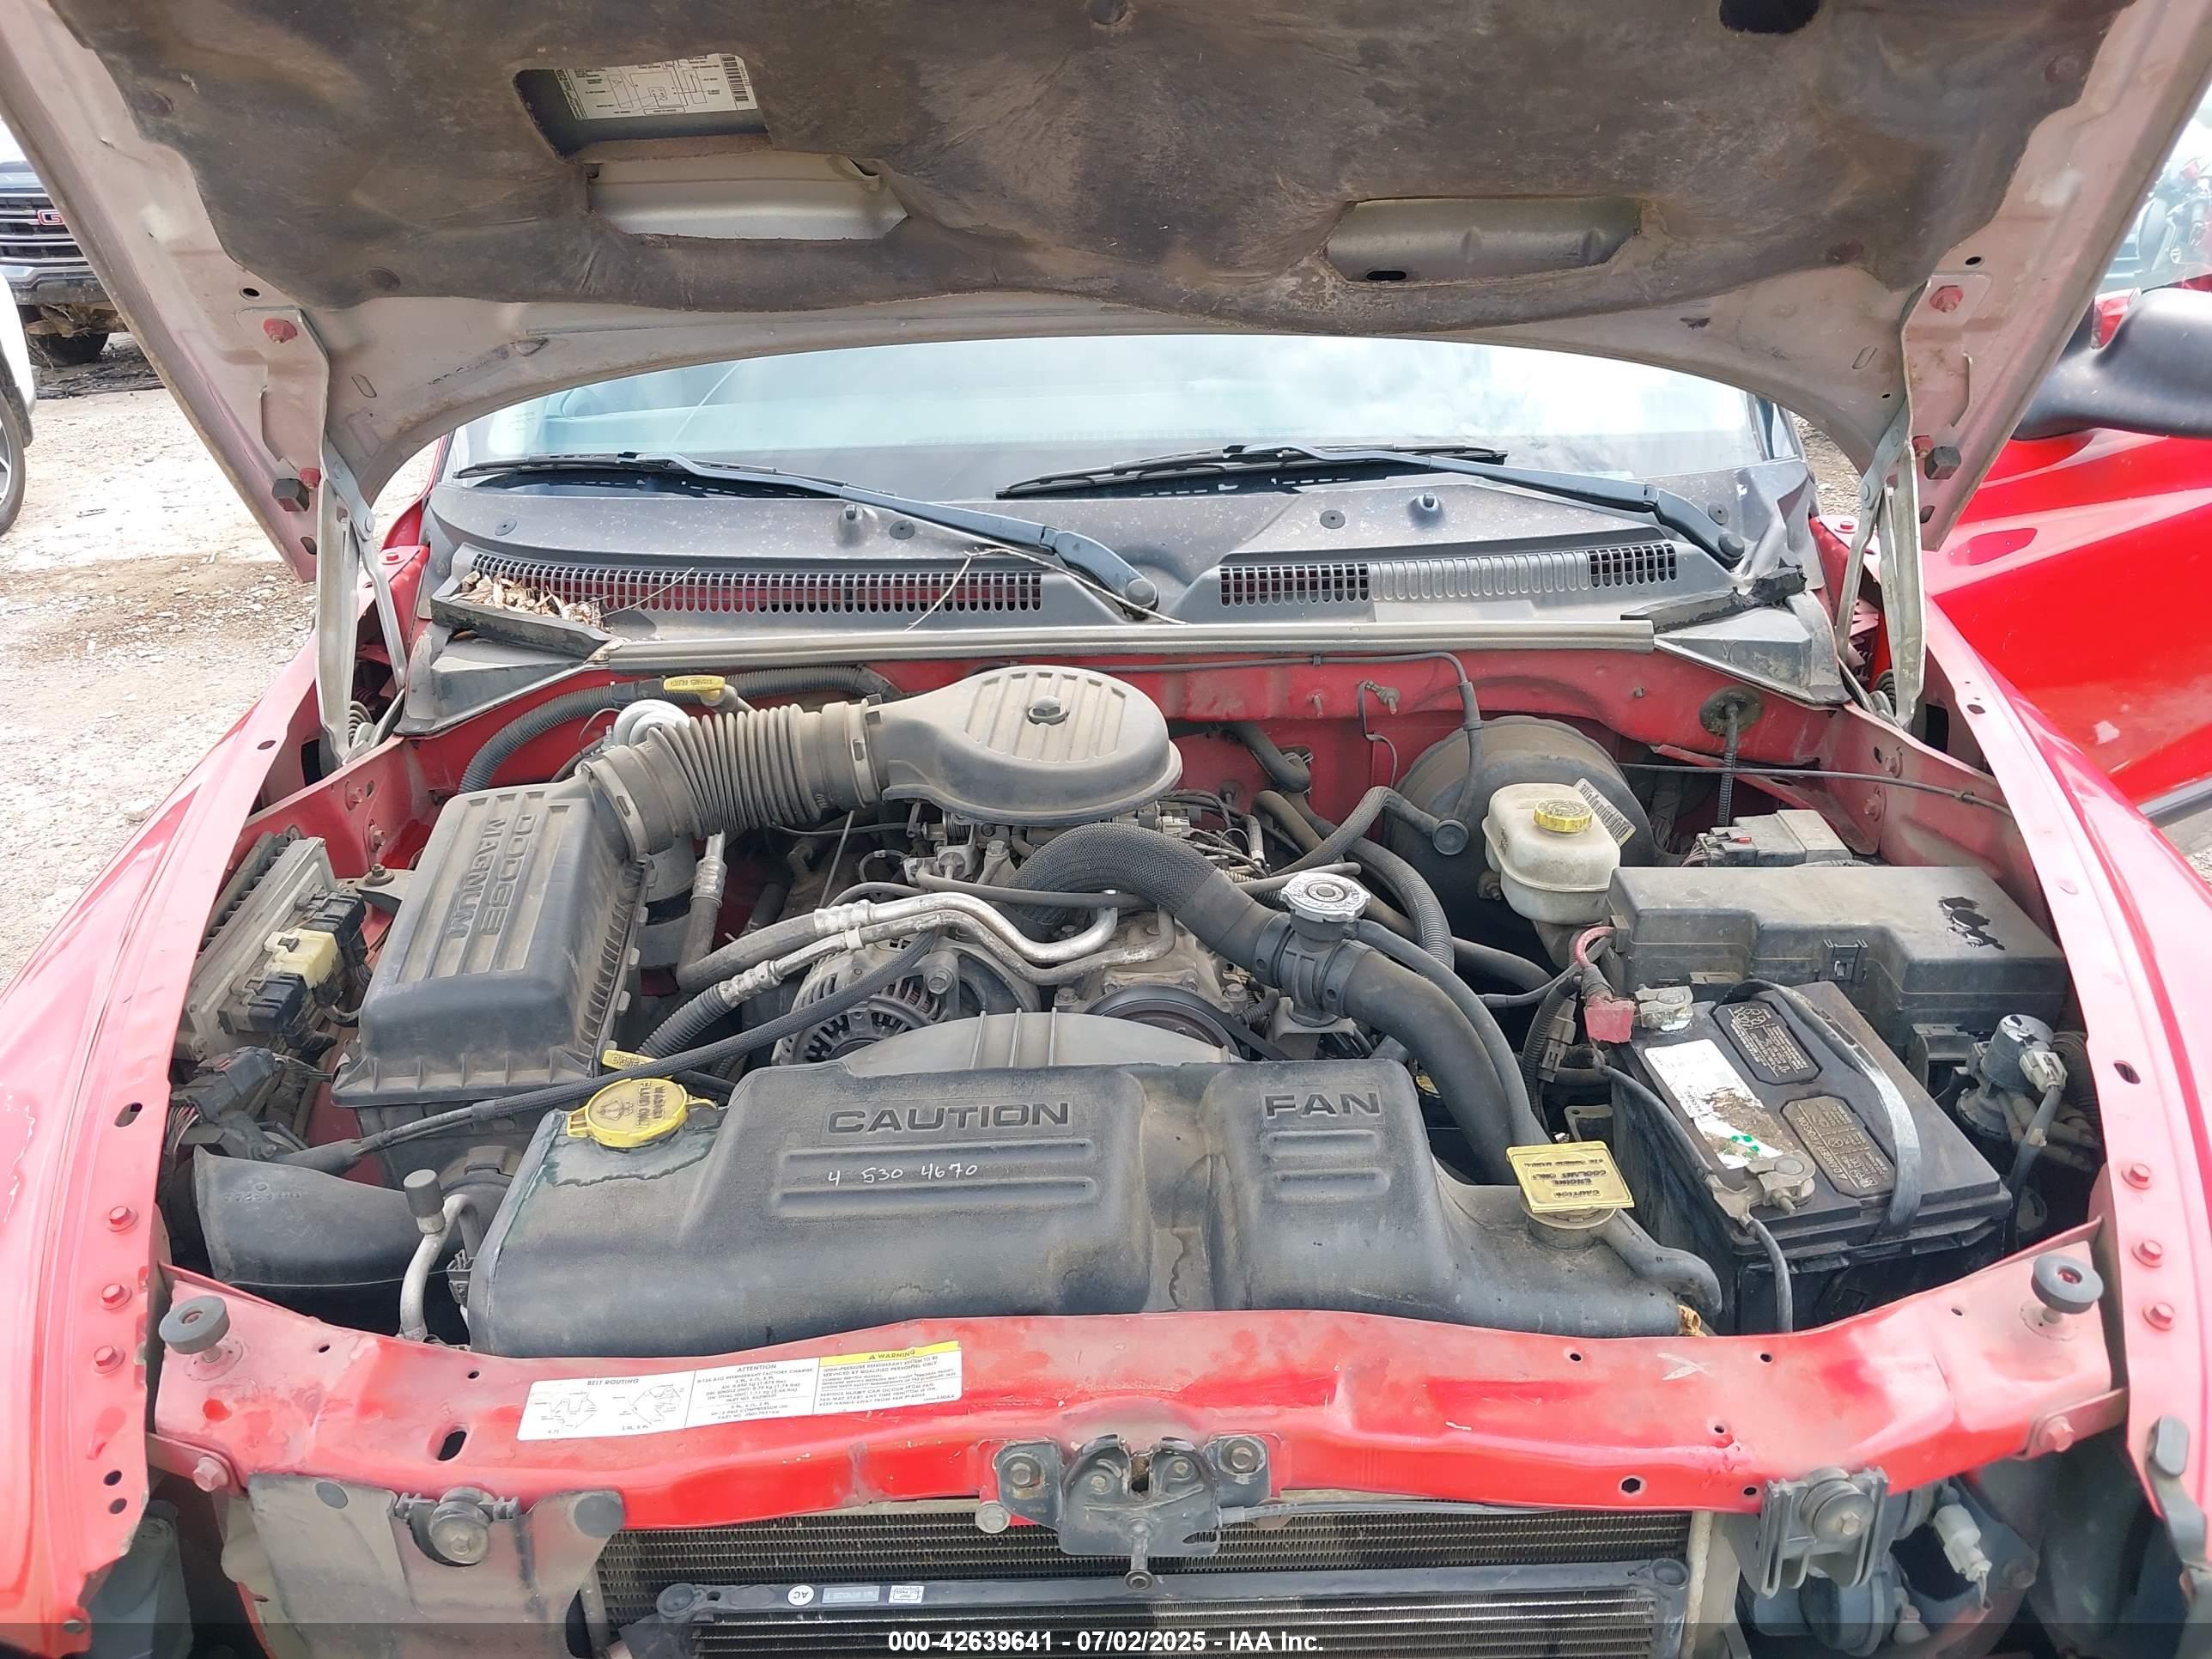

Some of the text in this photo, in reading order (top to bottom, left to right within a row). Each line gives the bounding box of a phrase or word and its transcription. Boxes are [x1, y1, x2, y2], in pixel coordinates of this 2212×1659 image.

[447, 817, 507, 939] MAGNUM
[481, 813, 533, 935] DODGE
[612, 1054, 639, 1067] ENGINE
[637, 1082, 651, 1127] FLUID ONLY
[653, 1085, 666, 1121] WASHER
[1265, 1092, 1381, 1117] FAN
[829, 1103, 1069, 1133] CAUTION
[1817, 1146, 1843, 1174] DANGER
[828, 1163, 978, 1188] 4 530 4670
[1562, 1170, 1607, 1178] COOLANT
[1554, 1189, 1600, 1198] CAUTION
[878, 1349, 915, 1359] WARNING
[793, 1590, 809, 1599] AC
